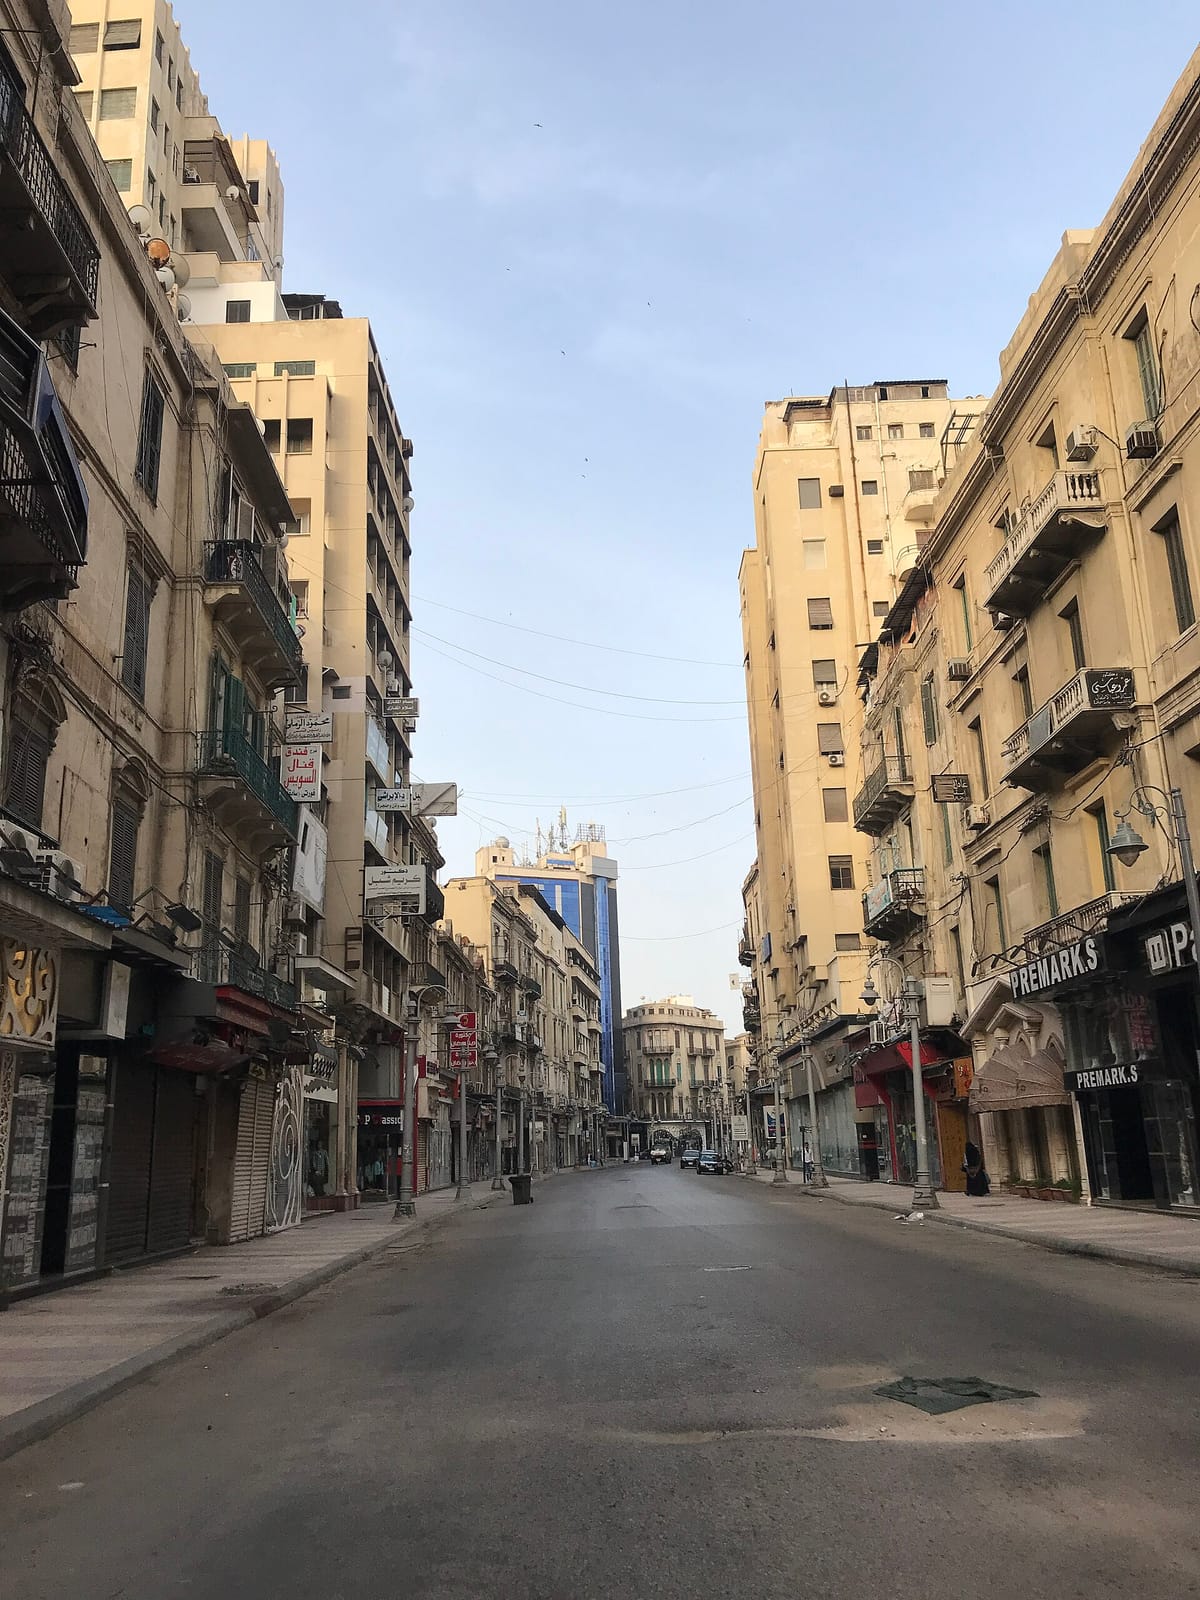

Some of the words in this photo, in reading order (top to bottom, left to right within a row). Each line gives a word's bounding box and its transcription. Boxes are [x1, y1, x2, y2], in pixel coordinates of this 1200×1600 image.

[285, 746, 308, 757] فندق
[287, 758, 314, 772] قنال
[284, 768, 316, 789] السويس
[1010, 938, 1098, 999] PREMARK.S
[1077, 1064, 1138, 1088] PREMARK.S
